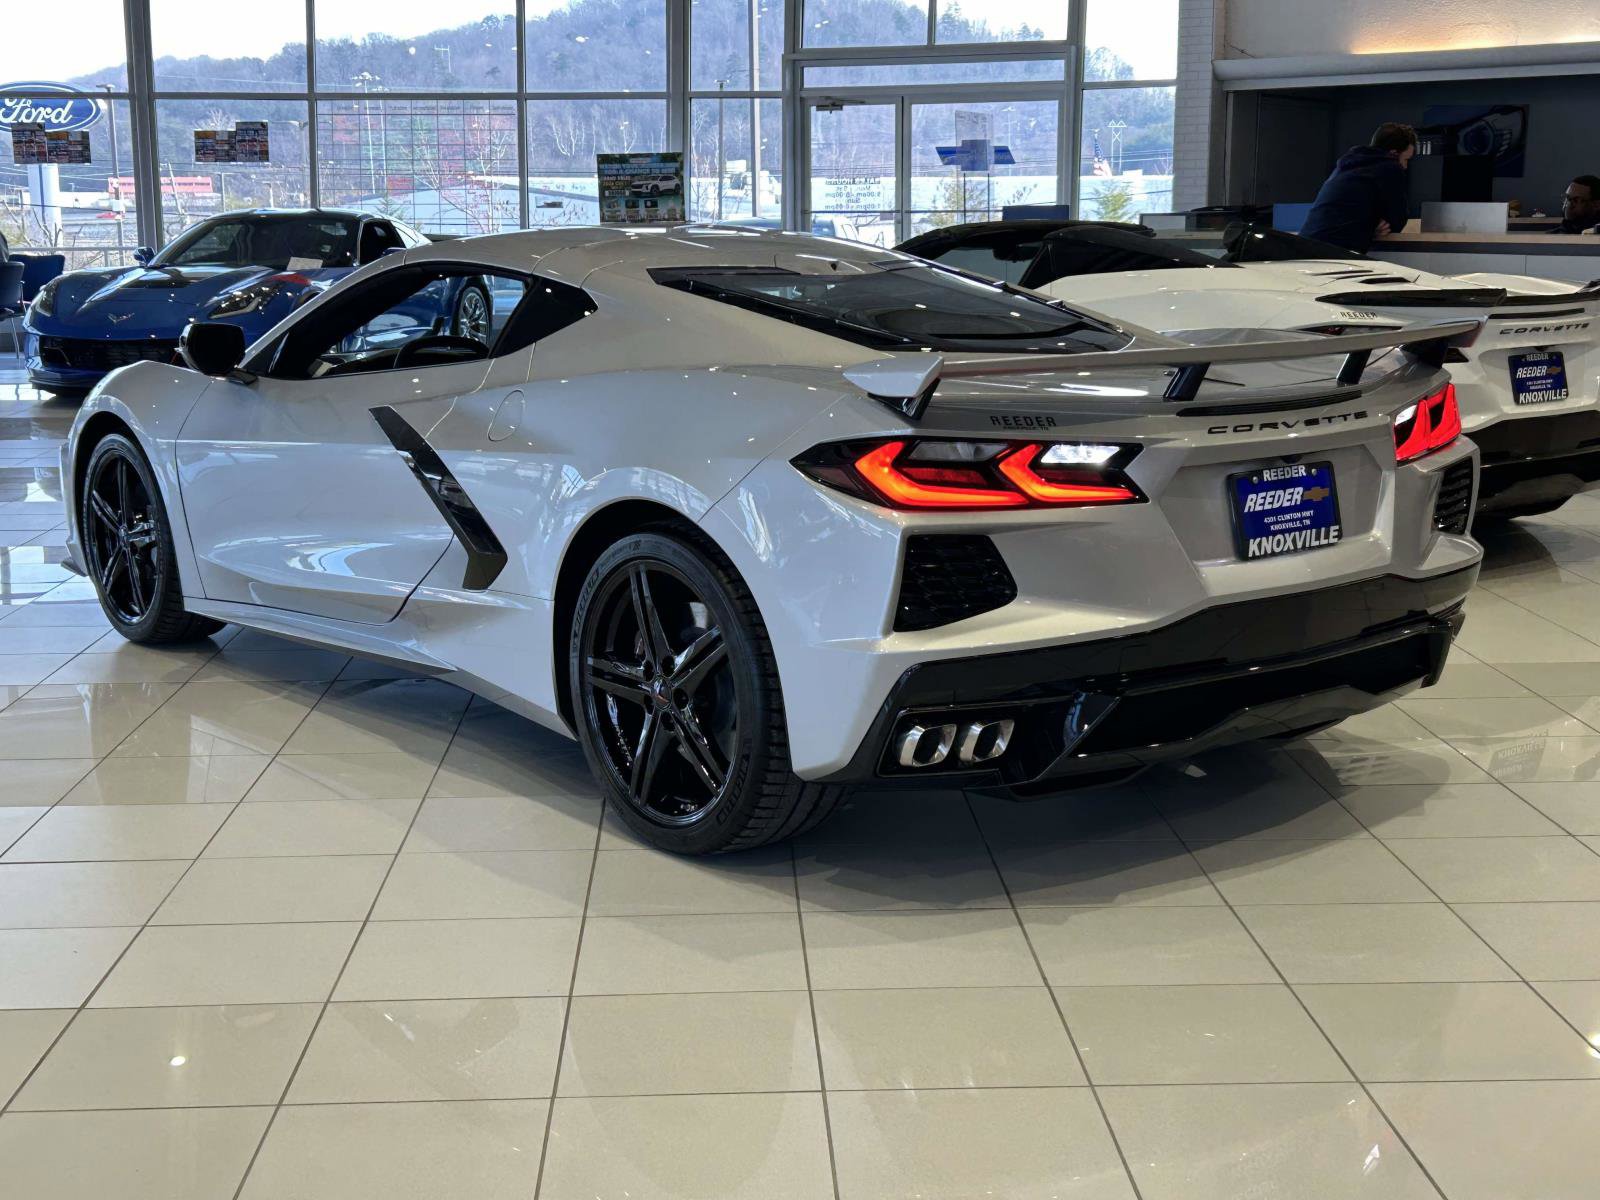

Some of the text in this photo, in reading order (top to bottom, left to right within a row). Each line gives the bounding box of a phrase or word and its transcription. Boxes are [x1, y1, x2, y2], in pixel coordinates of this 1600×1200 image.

[0, 98, 73, 123] Ford
[1499, 322, 1590, 335] CORVETTE
[1526, 353, 1549, 361] REEDER
[1516, 366, 1547, 378] REEDER
[1519, 388, 1567, 404] KNOXVILLE
[990, 415, 1057, 427] REEDER
[1207, 410, 1368, 434] CORVETTE
[1262, 465, 1307, 482] REEDER
[1244, 486, 1304, 513] REEDER
[1277, 512, 1301, 521] CLINTON
[1248, 525, 1340, 558] KNOXVILLE
